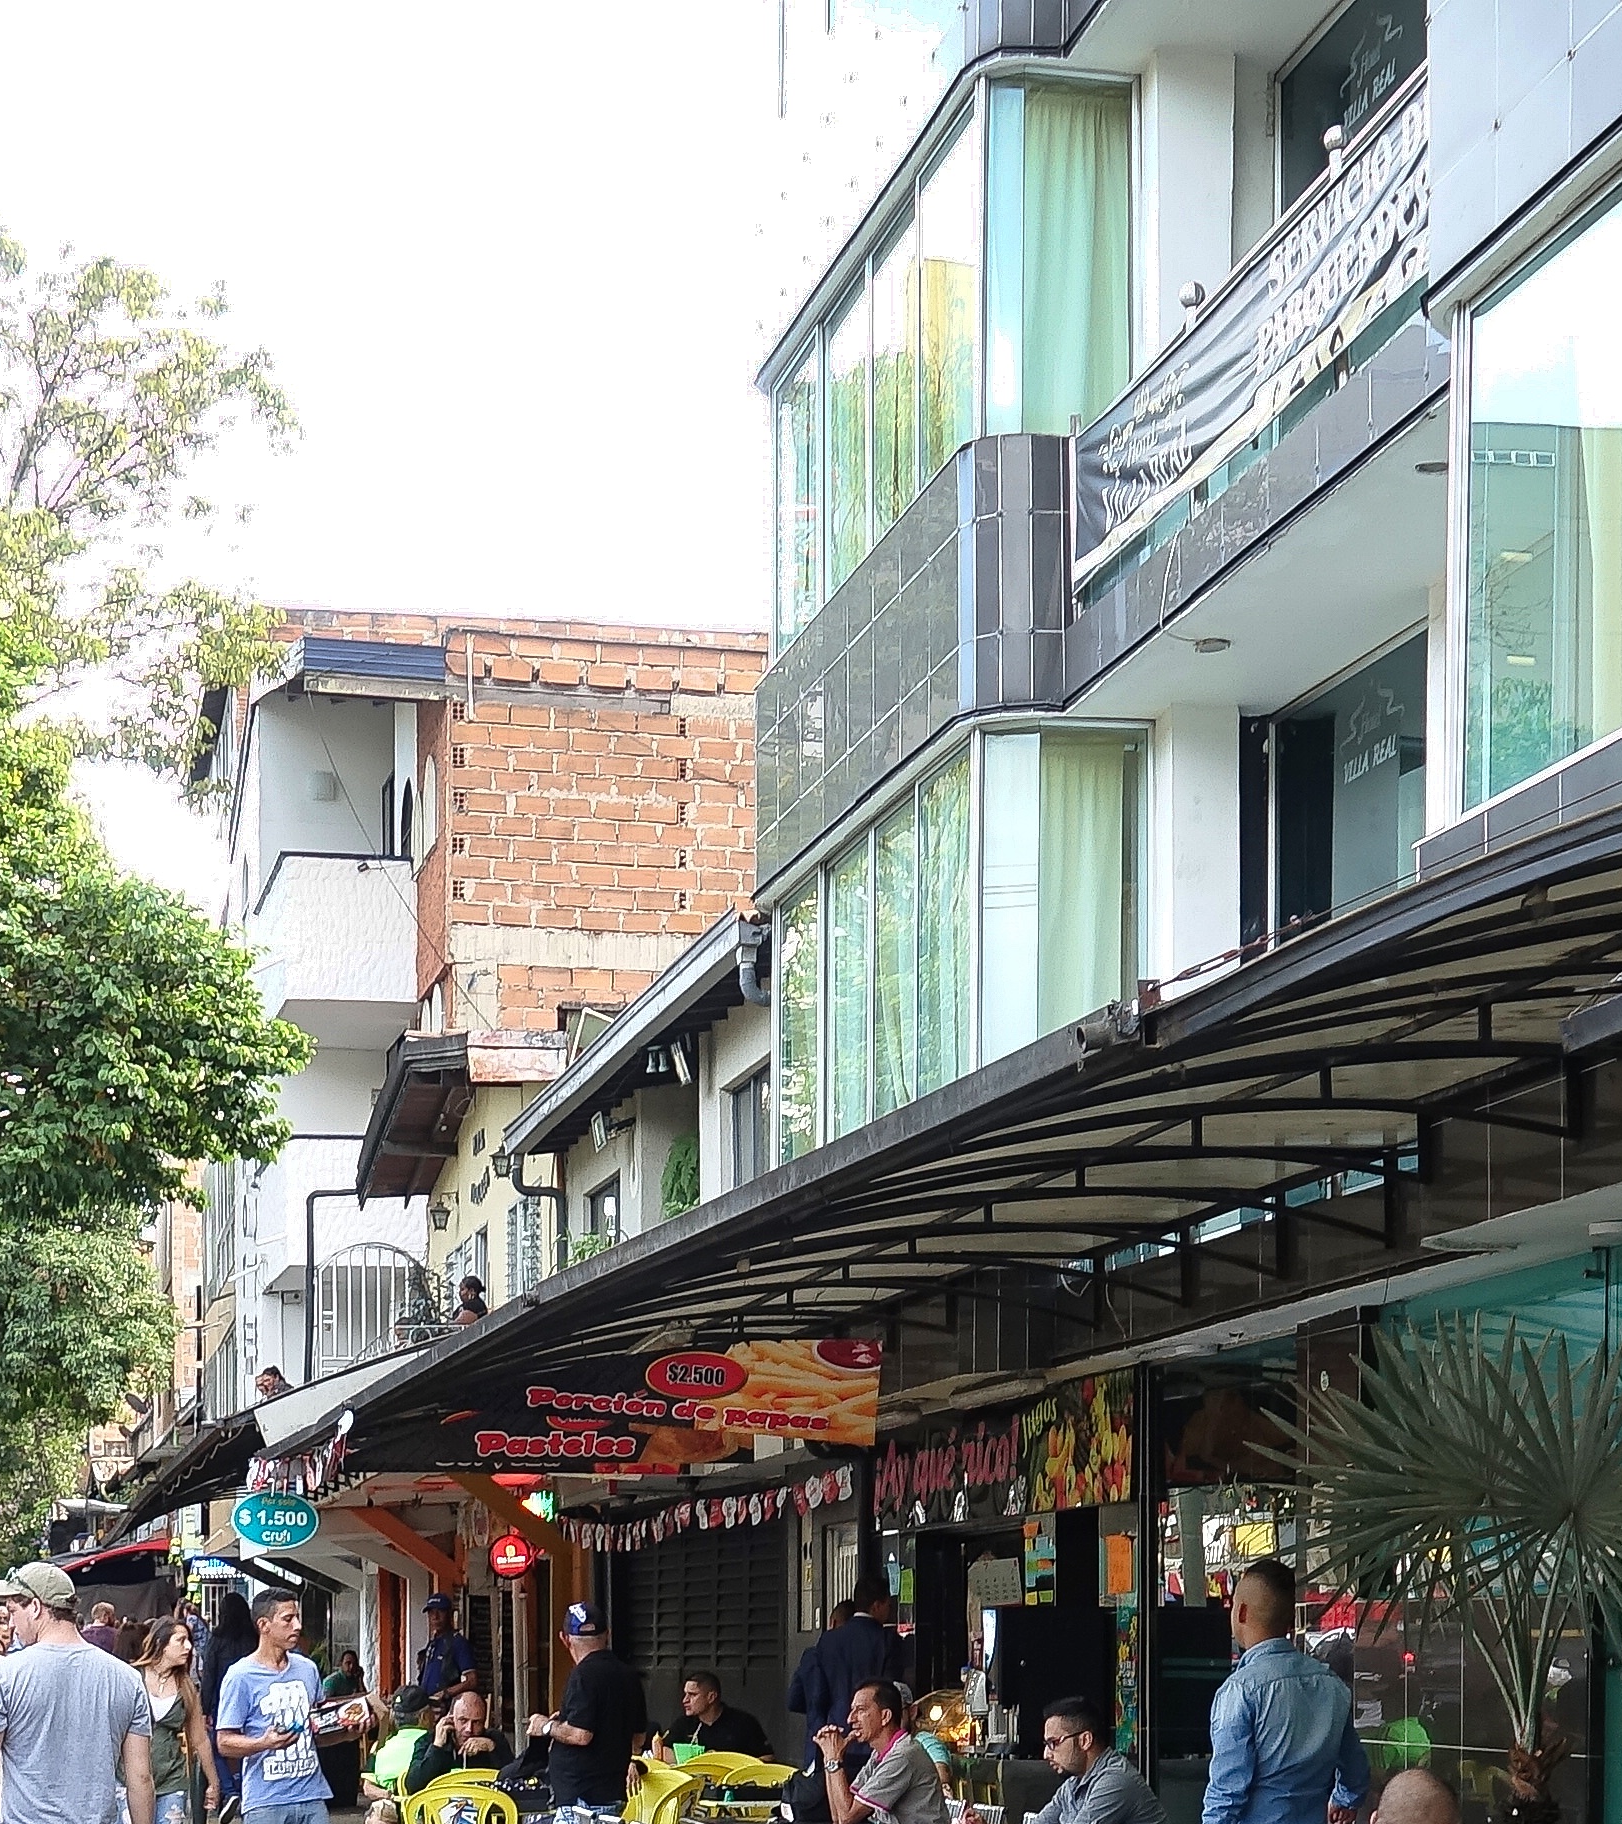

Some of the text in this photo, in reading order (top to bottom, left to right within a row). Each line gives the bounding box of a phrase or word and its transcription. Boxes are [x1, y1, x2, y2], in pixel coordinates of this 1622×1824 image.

[1372, 58, 1396, 102] REAL
[1342, 733, 1398, 785] VILLA REAL
[668, 1362, 725, 1387] $2.500
[526, 1386, 831, 1432] Porción de papas
[475, 1430, 636, 1458] Pasteles
[962, 1413, 1020, 1486] rico!
[257, 1509, 308, 1526] 1.500
